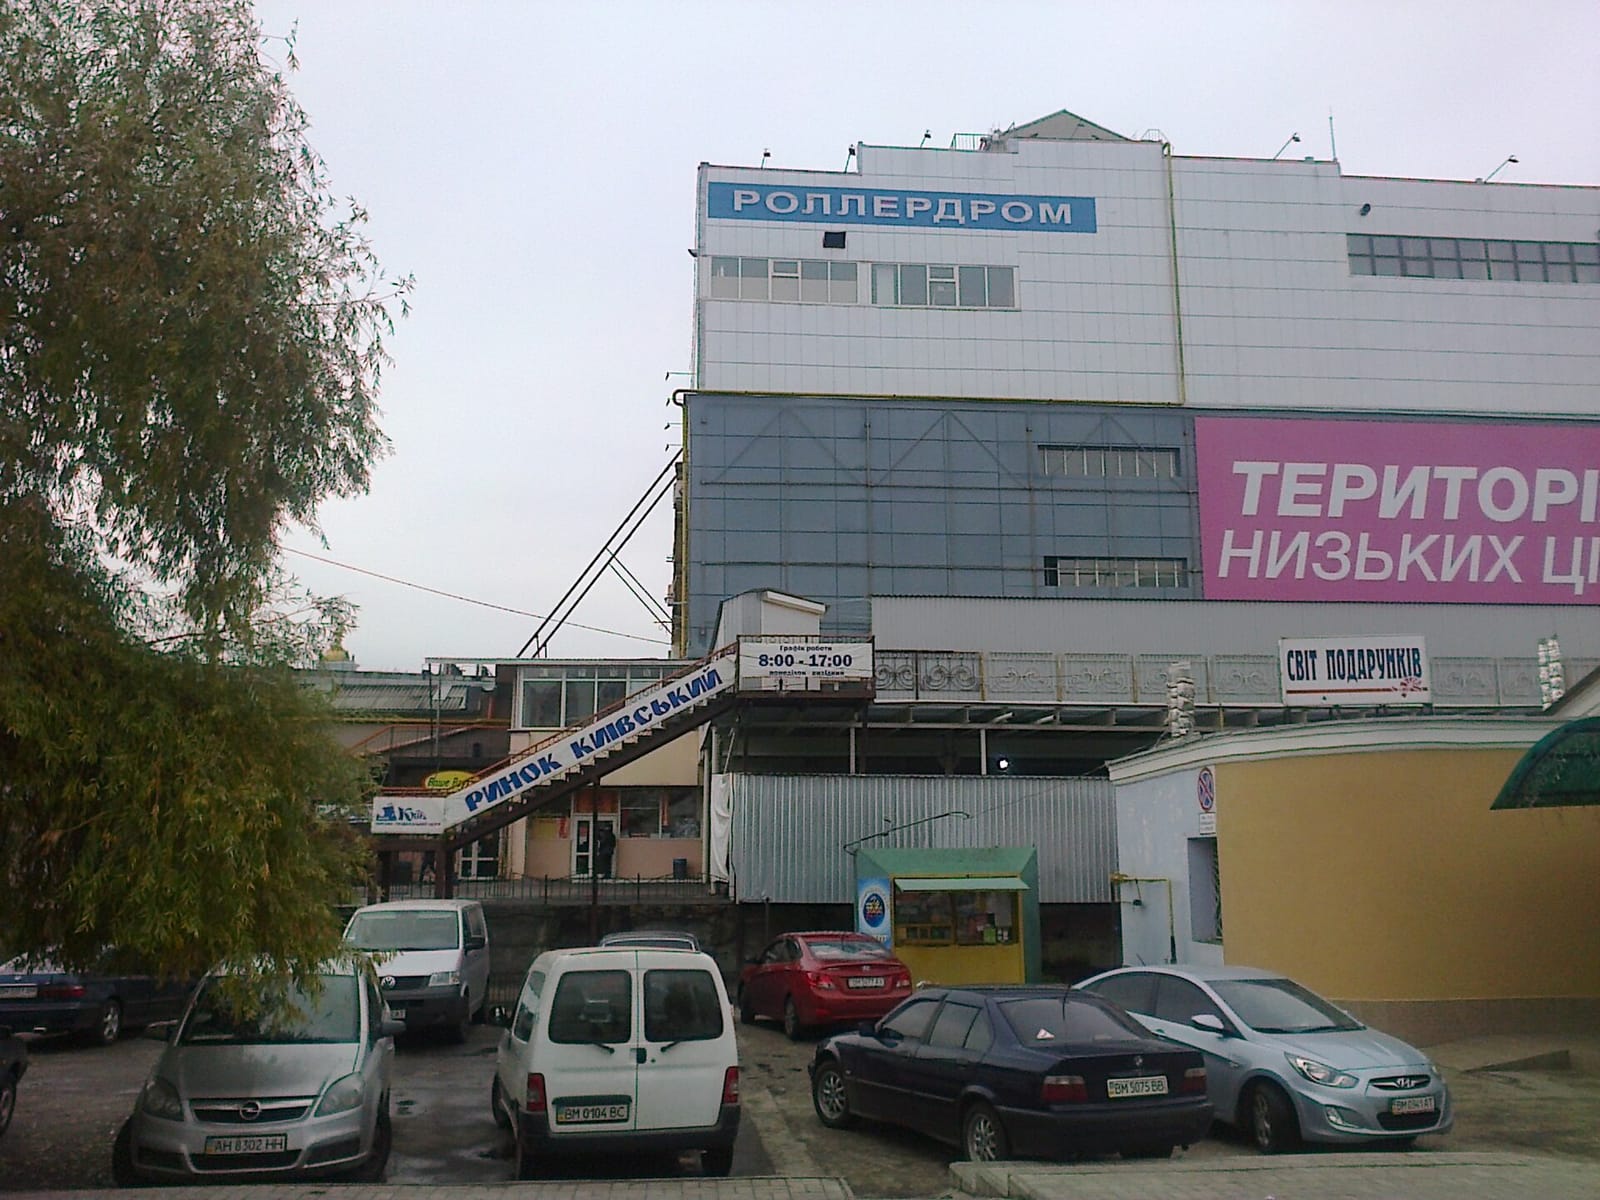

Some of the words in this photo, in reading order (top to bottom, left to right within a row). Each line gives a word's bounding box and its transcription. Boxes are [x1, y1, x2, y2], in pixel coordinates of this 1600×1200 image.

[733, 189, 1073, 225] РОЛЛЕРДРОМ
[1232, 460, 1600, 523] ТЕРИТОРІ
[1217, 529, 1526, 584] НИЗЬКИХ
[758, 654, 794, 667] 8:00
[808, 654, 852, 667] 17:00
[1287, 650, 1318, 682] СВІТ
[1326, 648, 1422, 684] ПОДАРУНКІВ
[464, 753, 562, 812] РИНОК
[564, 1107, 580, 1120] BM
[583, 1106, 607, 1119] 0104
[609, 1106, 625, 1118] BC
[215, 1141, 232, 1153] AH
[265, 1138, 283, 1150] HH
